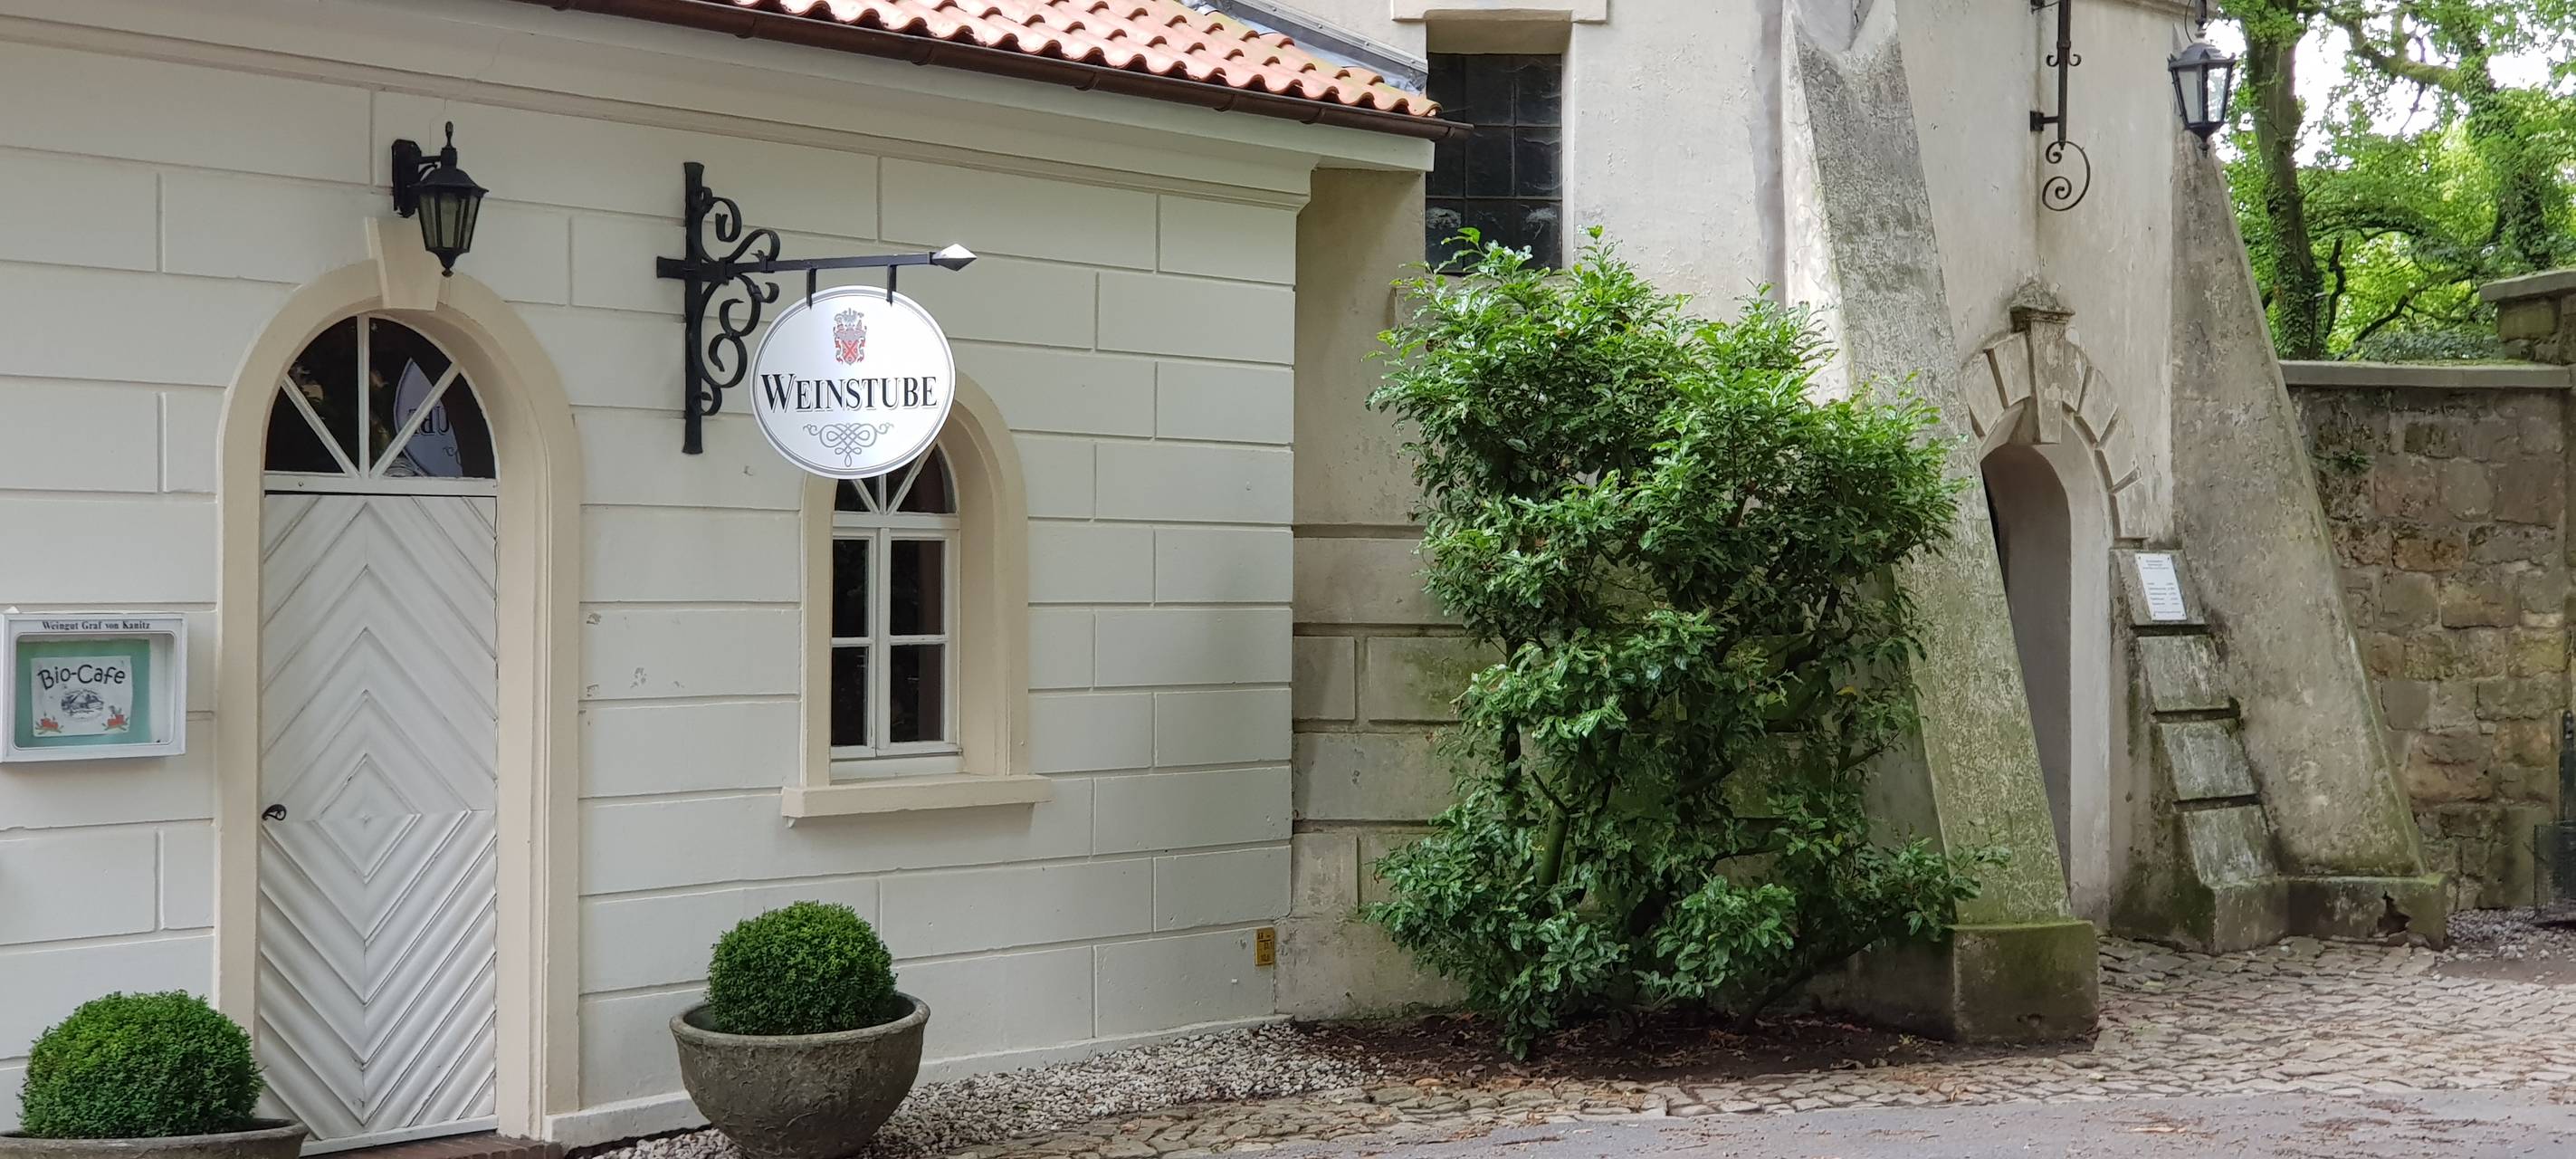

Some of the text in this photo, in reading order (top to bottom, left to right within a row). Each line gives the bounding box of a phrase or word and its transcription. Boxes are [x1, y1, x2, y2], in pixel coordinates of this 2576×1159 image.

[760, 373, 938, 413] WEINSTUBE
[42, 620, 151, 631] Weingut Graf von Kanitz
[37, 664, 126, 690] Bio-Cafe
